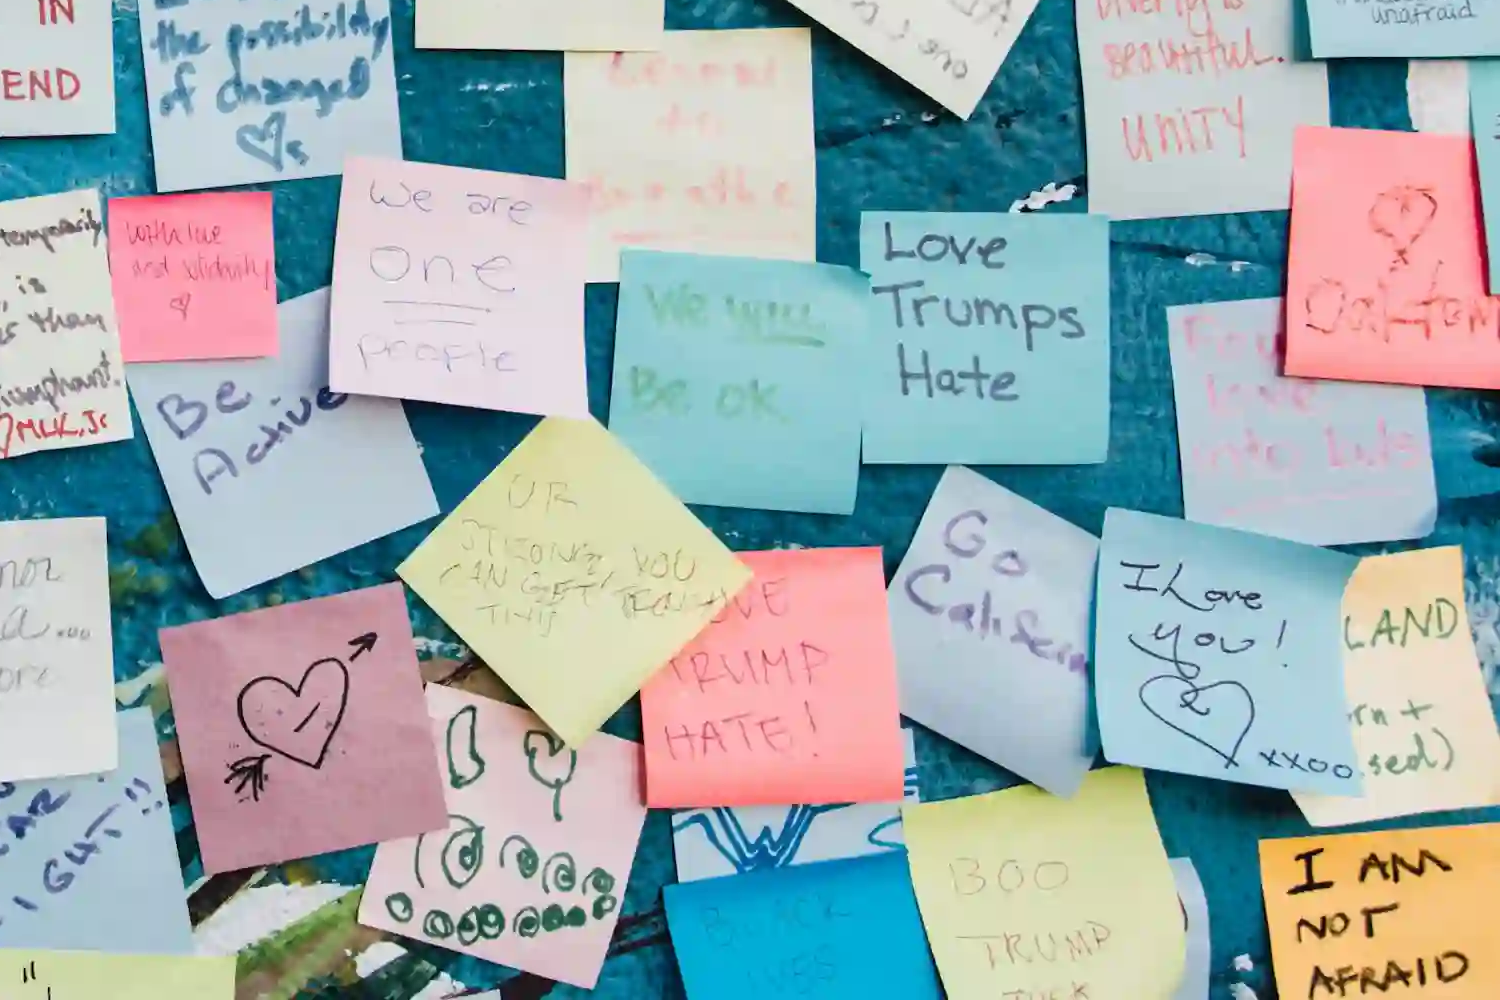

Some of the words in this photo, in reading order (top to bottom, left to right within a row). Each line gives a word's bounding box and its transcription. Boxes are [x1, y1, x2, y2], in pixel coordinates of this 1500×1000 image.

[2, 67, 81, 102] END
[882, 223, 1008, 269] Love
[15, 275, 47, 295] is
[872, 281, 1085, 351] Trumps
[897, 343, 1019, 402] Hate
[157, 381, 252, 439] Be
[192, 385, 347, 494] Active
[1287, 848, 1335, 895] I
[1359, 850, 1452, 884] AM
[1297, 904, 1399, 942] NOT
[1310, 952, 1468, 1000] AFRAID
